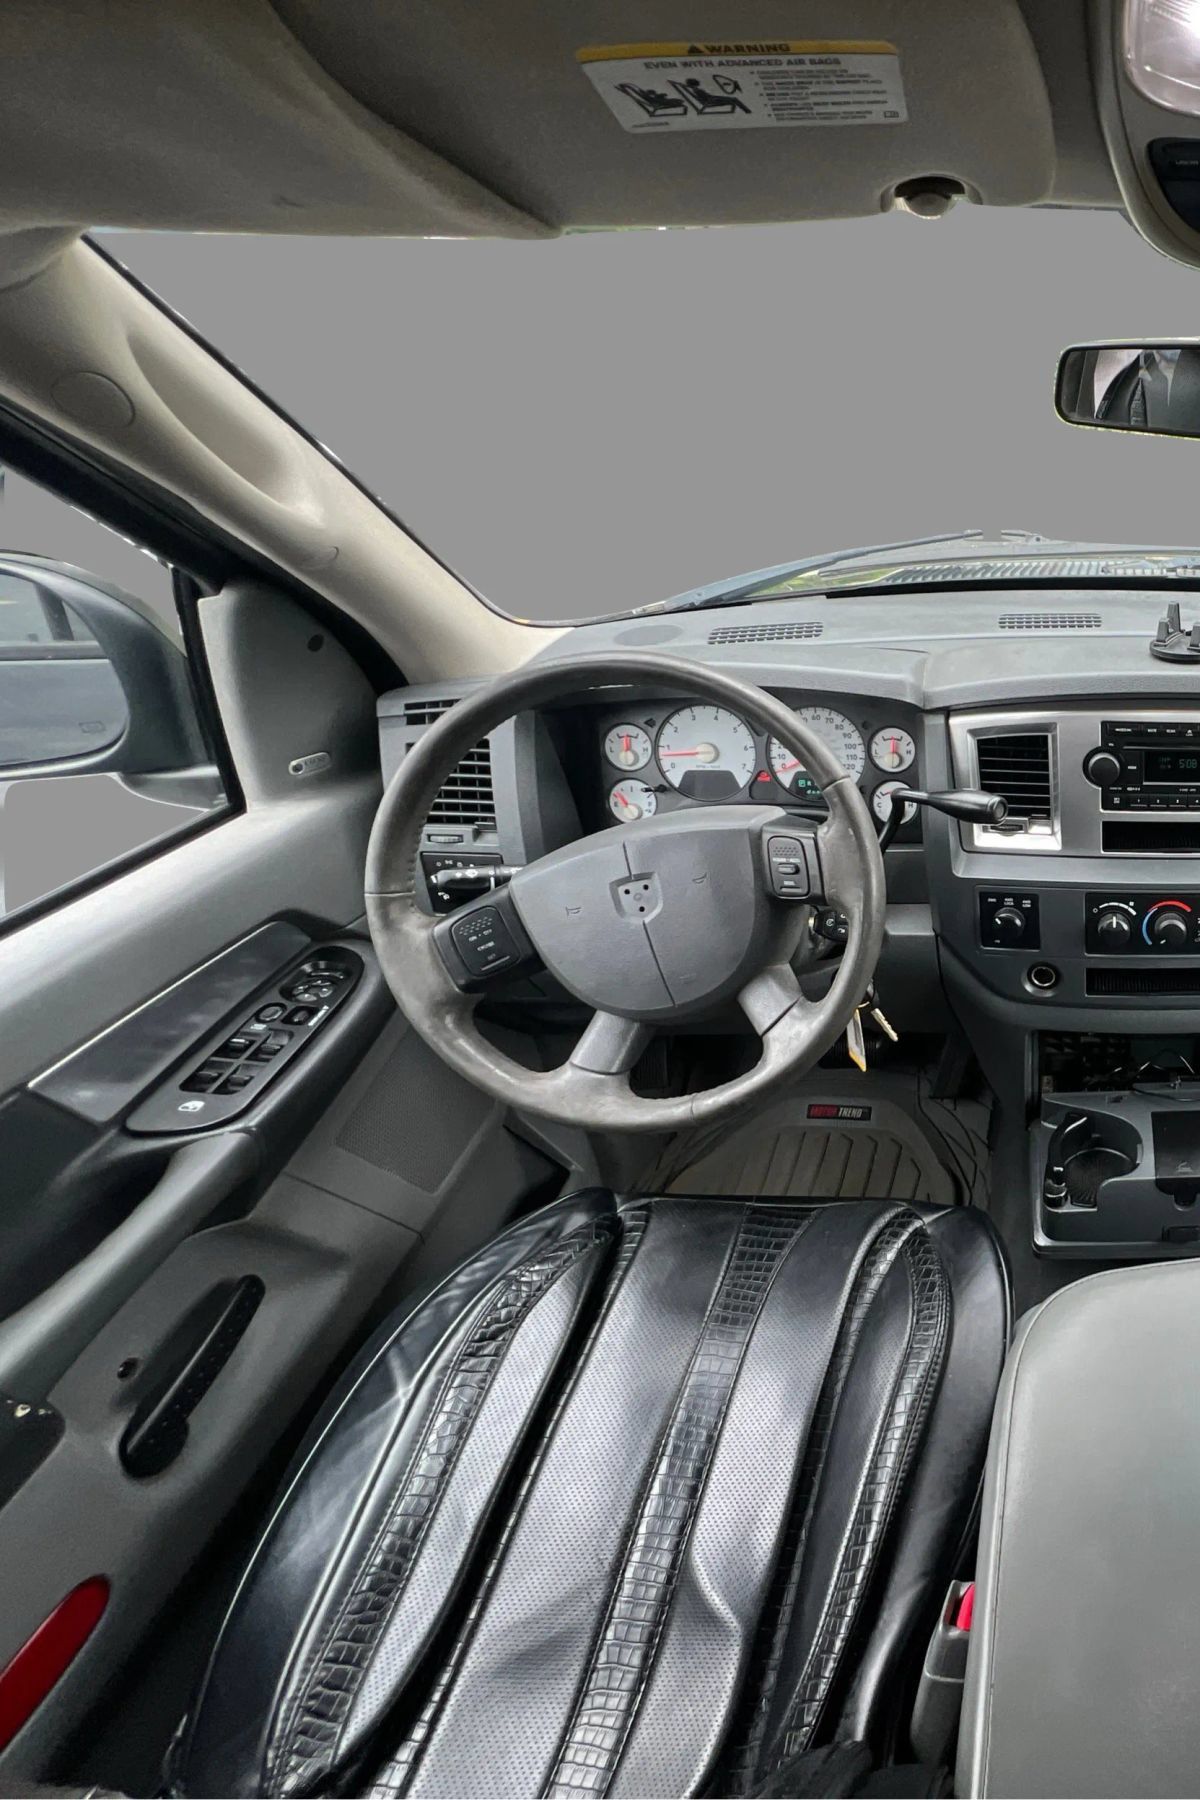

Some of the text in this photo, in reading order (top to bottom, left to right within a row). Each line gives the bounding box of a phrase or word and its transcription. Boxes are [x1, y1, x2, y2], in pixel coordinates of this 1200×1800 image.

[704, 43, 791, 54] WARNING
[643, 58, 841, 70] EVEN WITH ADVANCED AIR BAGS
